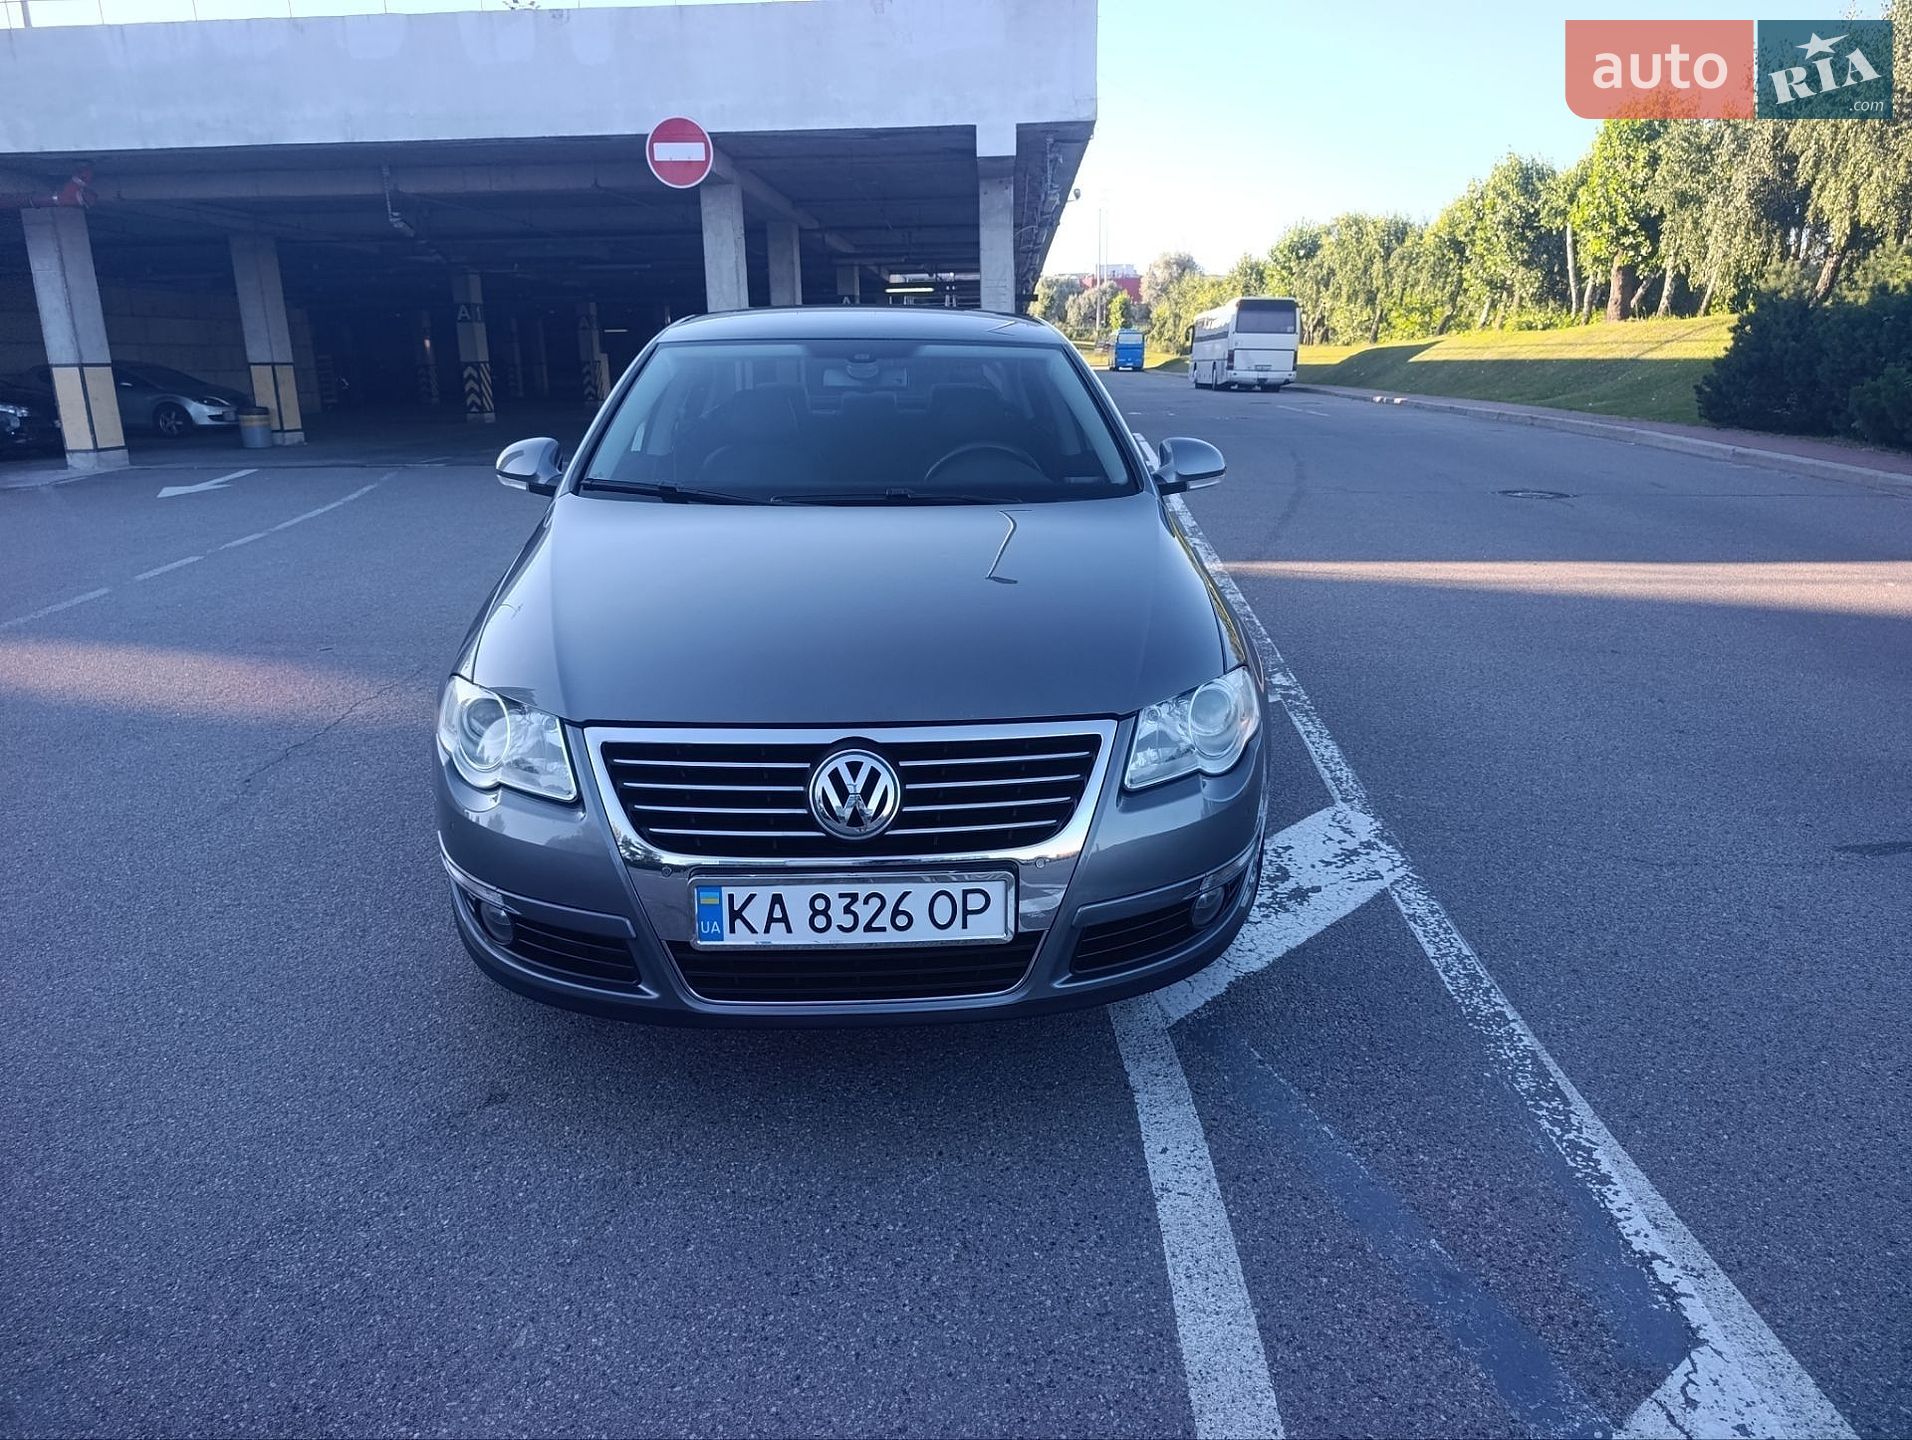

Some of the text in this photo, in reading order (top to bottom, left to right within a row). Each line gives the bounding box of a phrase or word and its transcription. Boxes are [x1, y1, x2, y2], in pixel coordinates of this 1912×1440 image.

[728, 889, 991, 934] KA 8326 OP
[701, 921, 721, 933] UA
